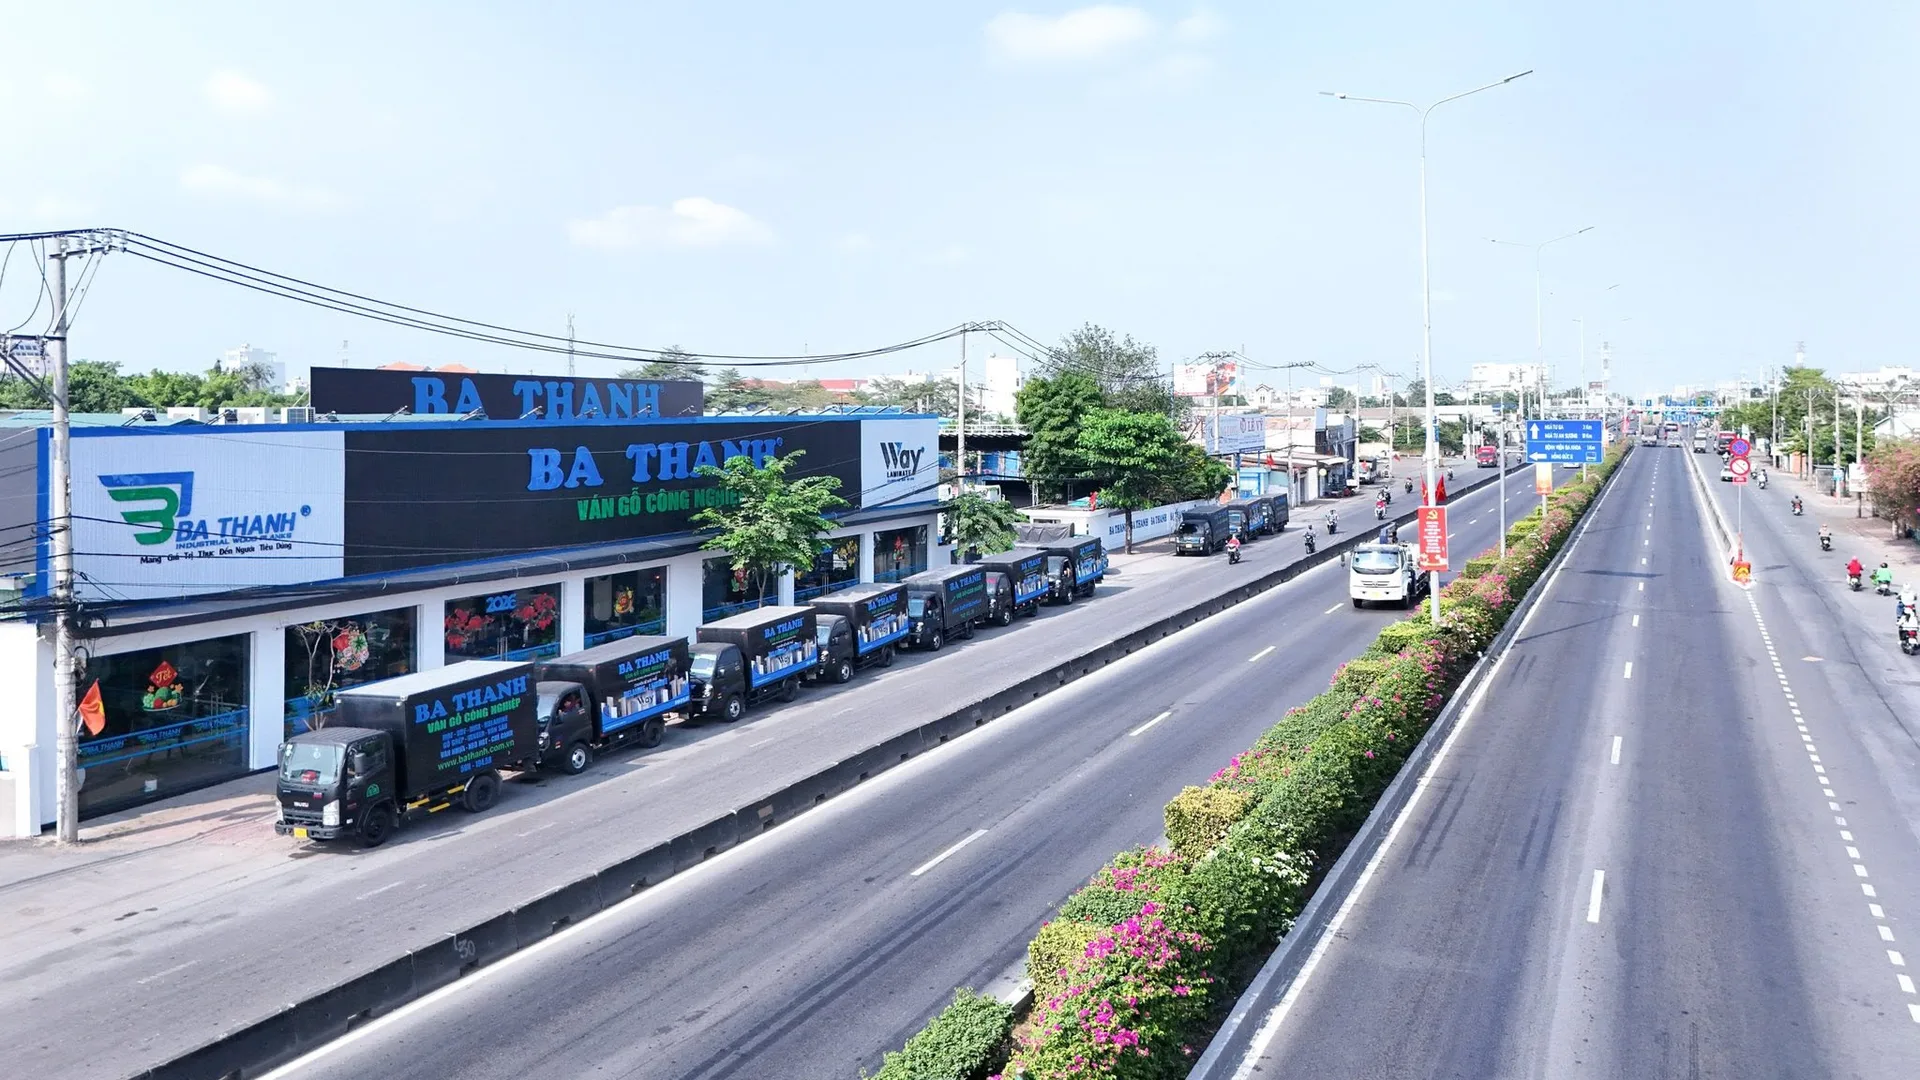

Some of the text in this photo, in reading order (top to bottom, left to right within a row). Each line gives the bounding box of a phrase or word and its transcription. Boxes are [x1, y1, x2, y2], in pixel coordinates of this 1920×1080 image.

[411, 377, 662, 420] BA THANH
[527, 439, 777, 491] BA THANH
[880, 442, 922, 476] Way
[577, 494, 615, 521] VÁN
[618, 486, 641, 515] GỖ
[646, 488, 690, 513] CÔNG
[175, 511, 297, 543] BA THANH
[175, 538, 230, 550] INDUSTRIAL
[764, 627, 776, 639] BA
[777, 618, 804, 634] THANH
[618, 650, 670, 675] BA THANH
[415, 676, 527, 724] BA THANH
[438, 739, 515, 771] www.bathanh.com.vn
